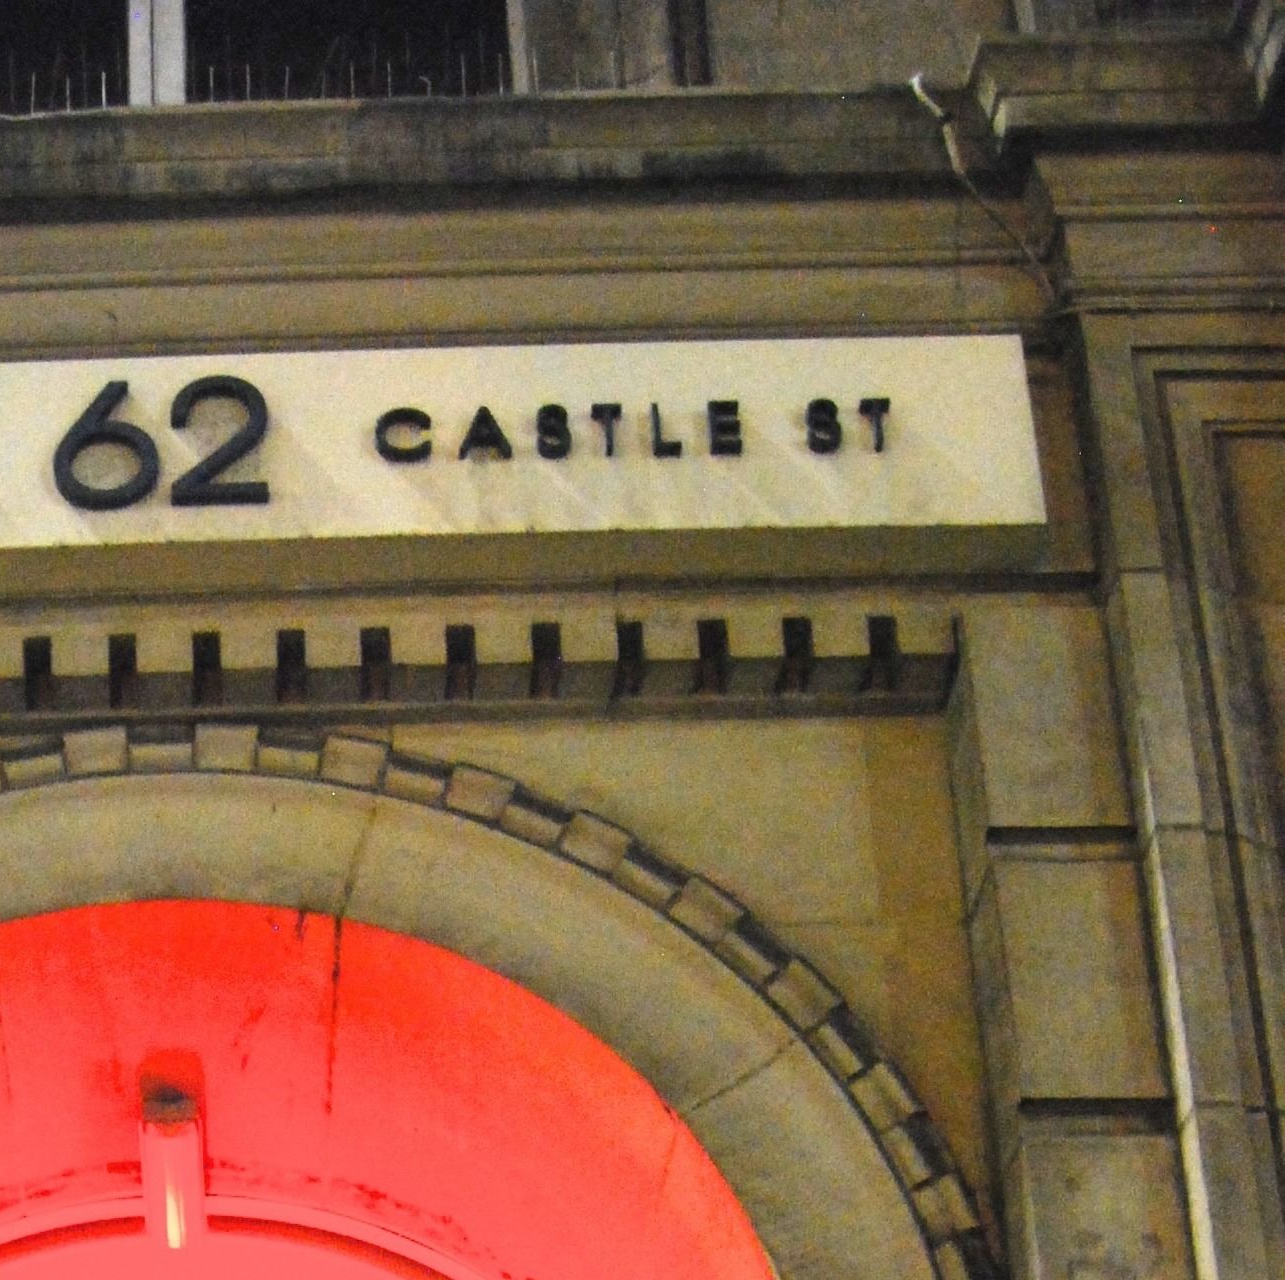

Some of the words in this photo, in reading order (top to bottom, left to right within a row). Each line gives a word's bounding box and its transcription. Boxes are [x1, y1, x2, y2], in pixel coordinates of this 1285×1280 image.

[53, 375, 270, 512] 62
[374, 400, 743, 464] CASTLE
[805, 397, 891, 454] ST
